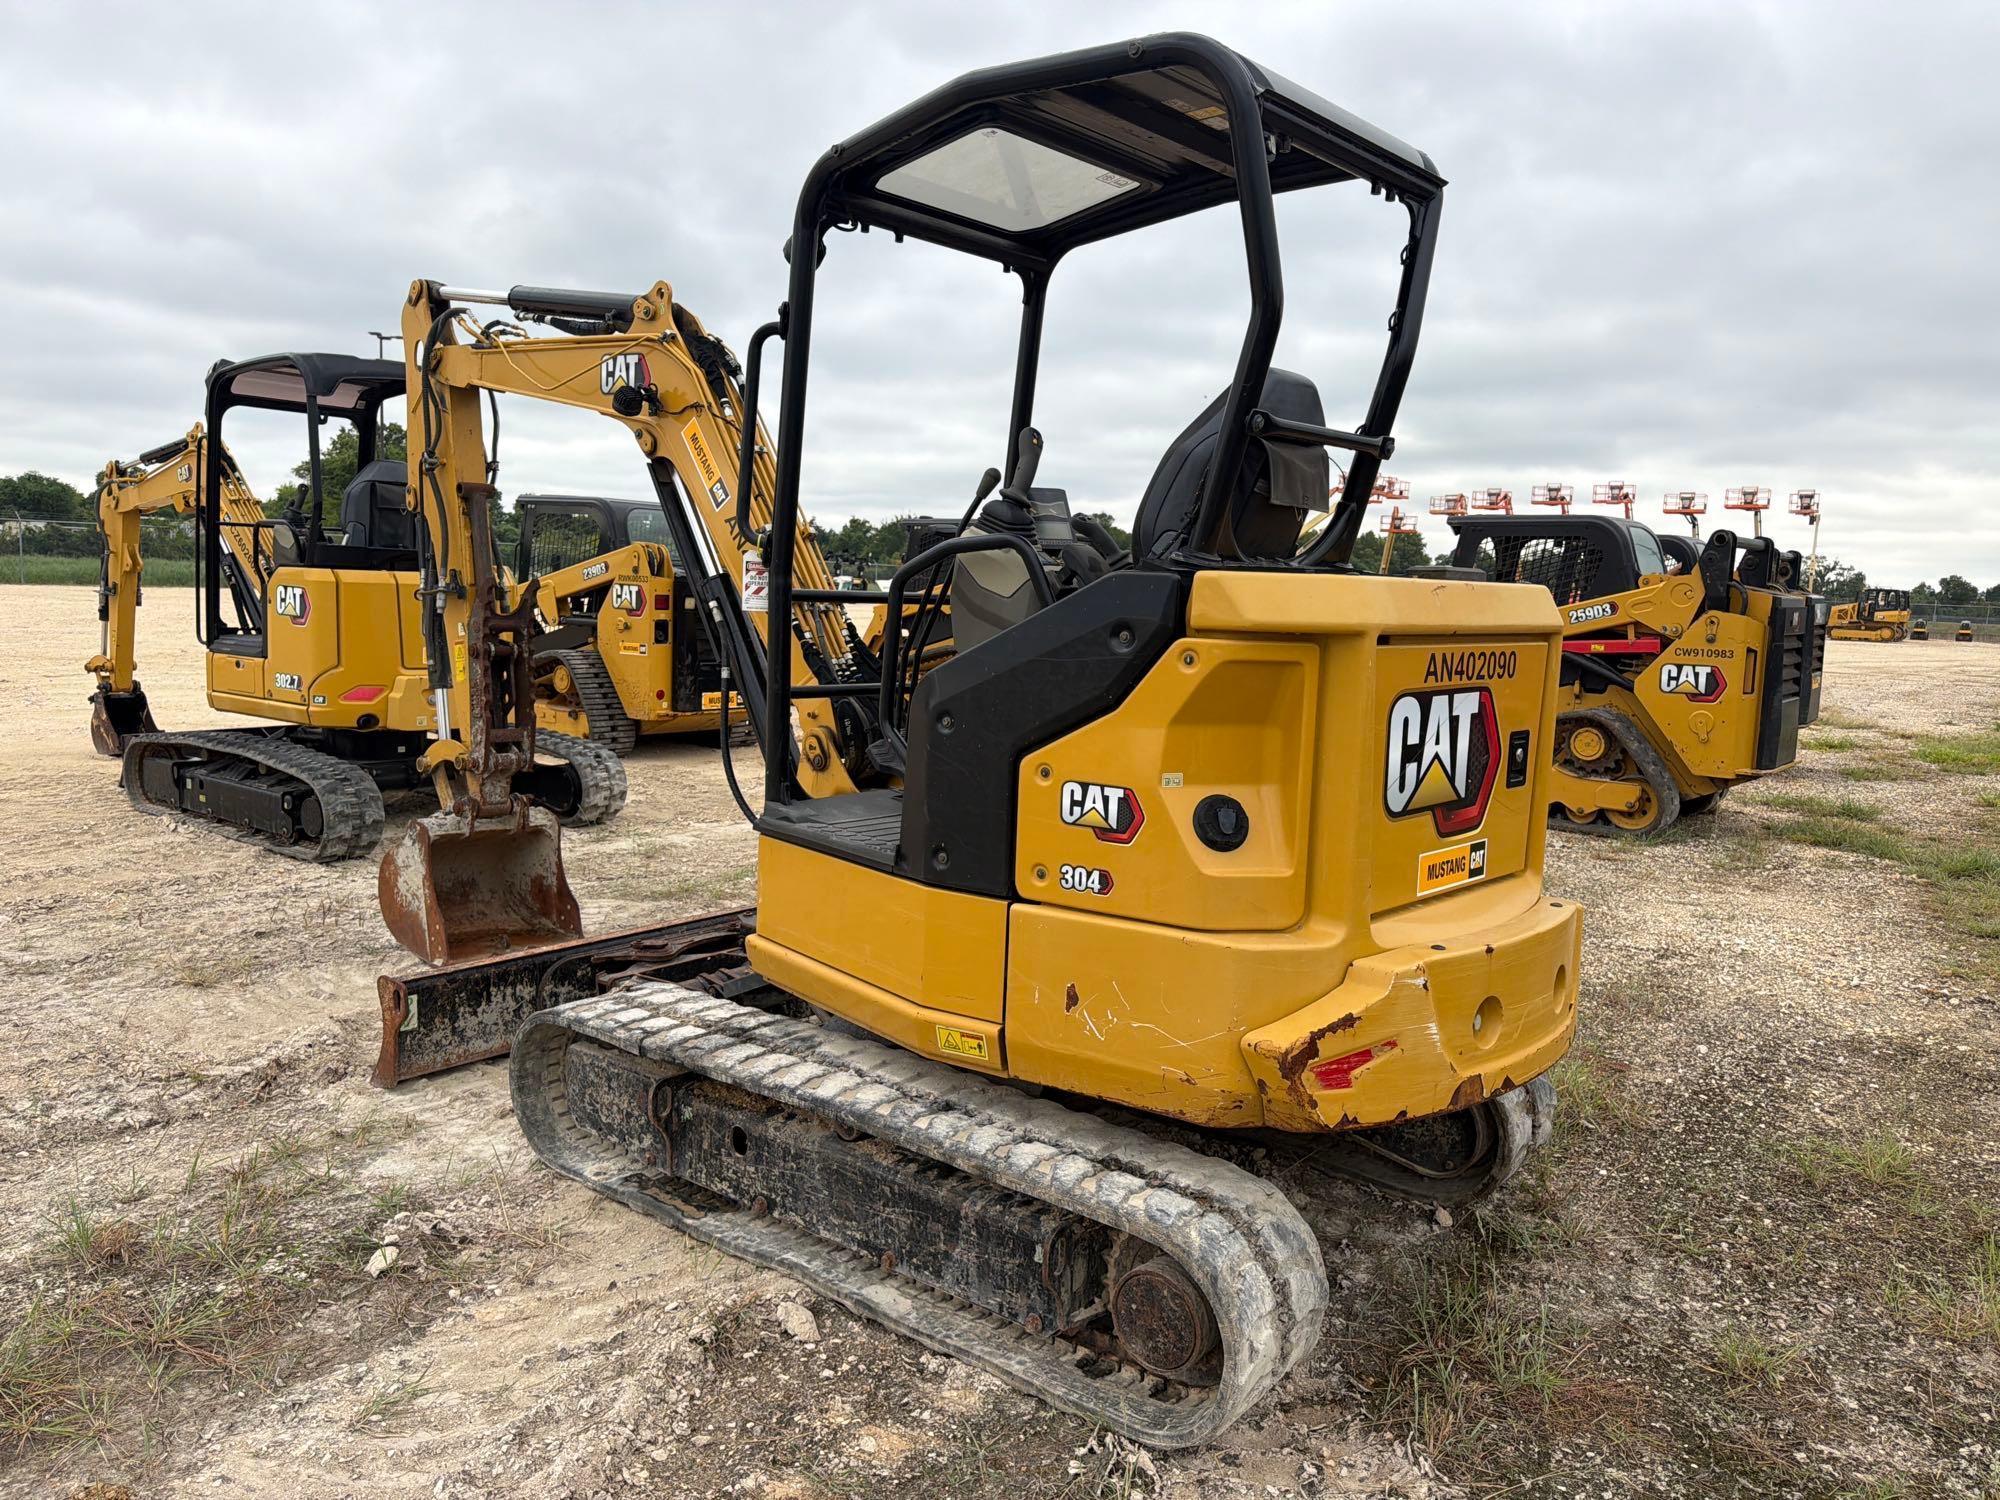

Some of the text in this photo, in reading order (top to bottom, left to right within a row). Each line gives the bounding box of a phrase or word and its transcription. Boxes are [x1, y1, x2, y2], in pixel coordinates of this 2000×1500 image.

[601, 354, 639, 394] CAT
[689, 432, 726, 503] MUSTANG CAT
[276, 585, 303, 617] CAT
[612, 583, 639, 610] CAT
[1568, 602, 1612, 624] 259D3
[1424, 651, 1517, 684] AN402090
[1674, 647, 1735, 659] CW910983
[275, 673, 299, 690] 302.7
[1660, 664, 1712, 695] CAT
[1386, 691, 1480, 813] CAT
[1061, 781, 1125, 830] CAT
[1060, 865, 1101, 893] 304
[1427, 850, 1485, 881] MUSTANG CAT
